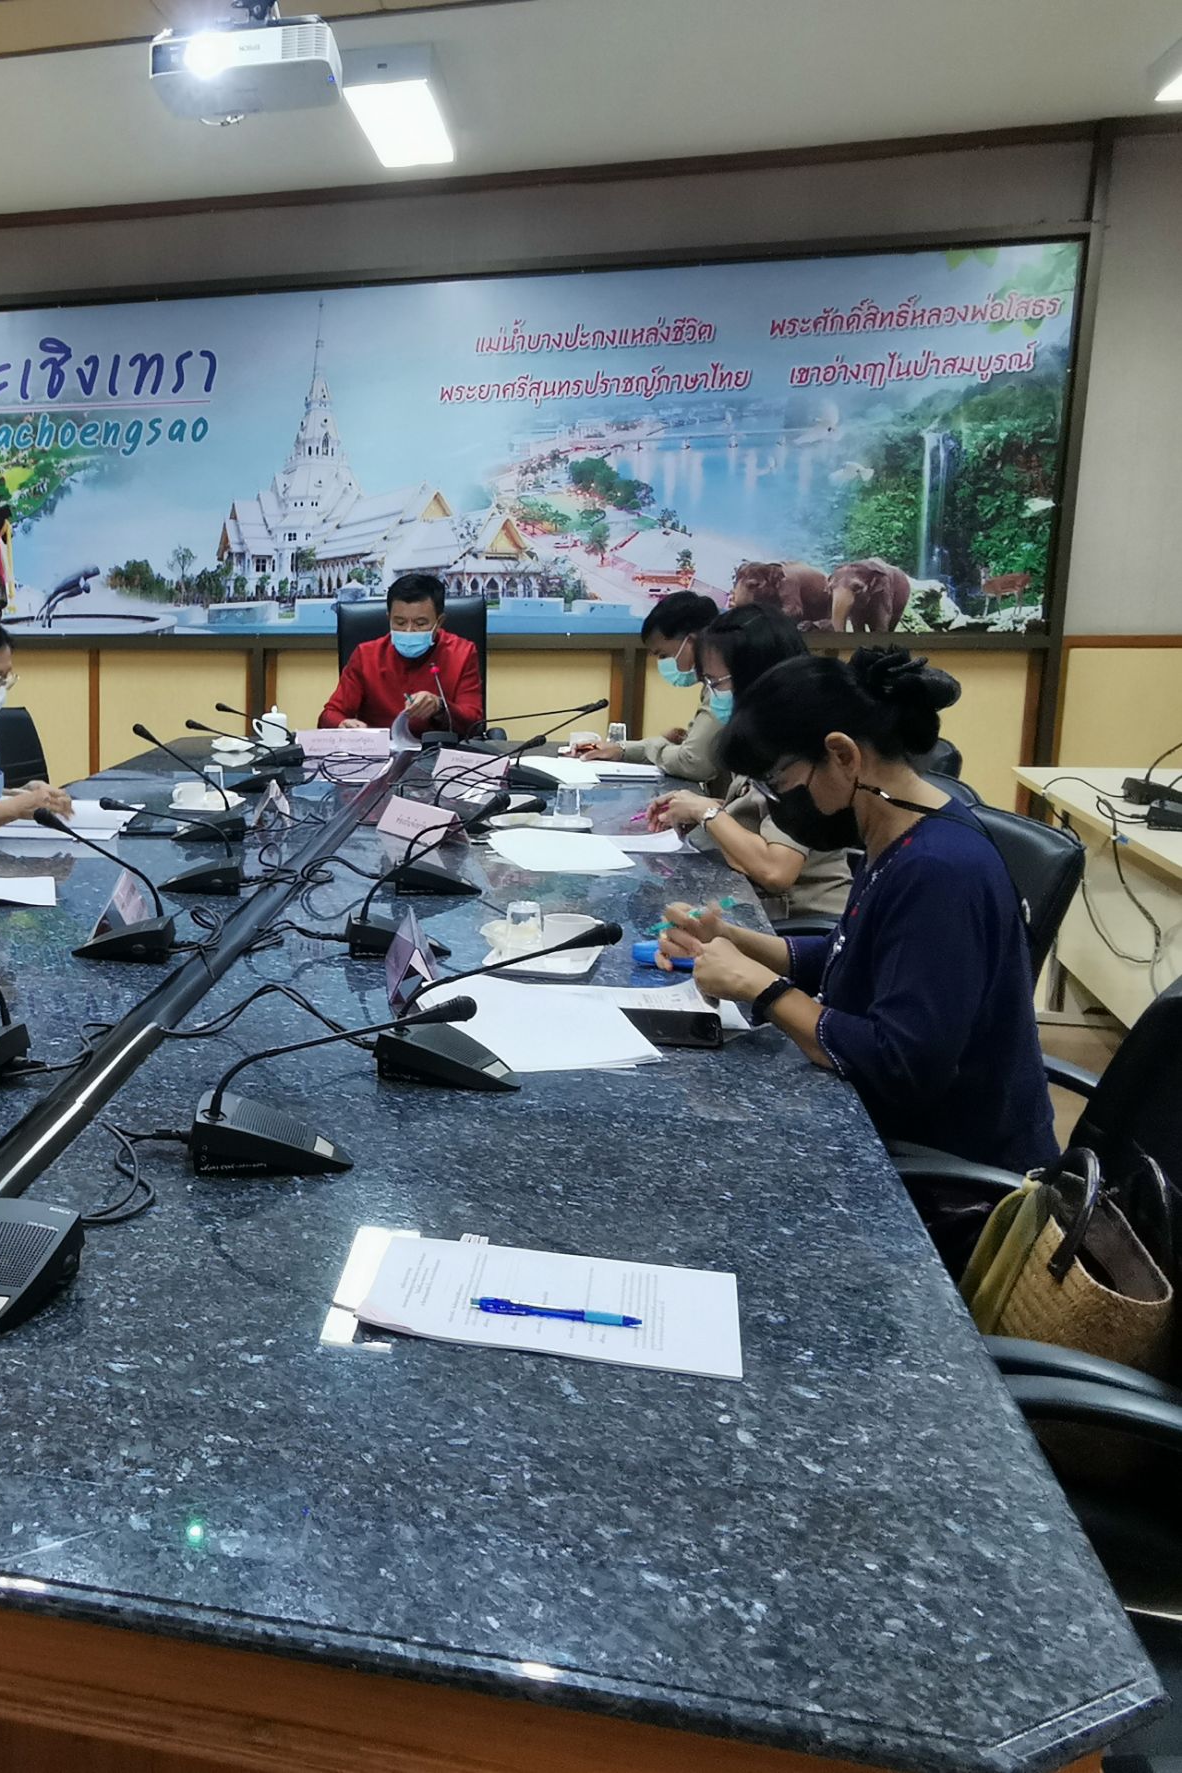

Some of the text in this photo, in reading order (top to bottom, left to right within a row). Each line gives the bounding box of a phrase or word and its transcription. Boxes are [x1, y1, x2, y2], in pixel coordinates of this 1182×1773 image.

[475, 317, 716, 354] แม่น้ำบางปะกงแหล่งชีวิต
[769, 294, 1061, 339] พระศักดิ์สิทธิ์หลวงพ่อโสธร
[439, 362, 751, 407] พระยาศรีสุนทรปราชญ์ภาษาไทย
